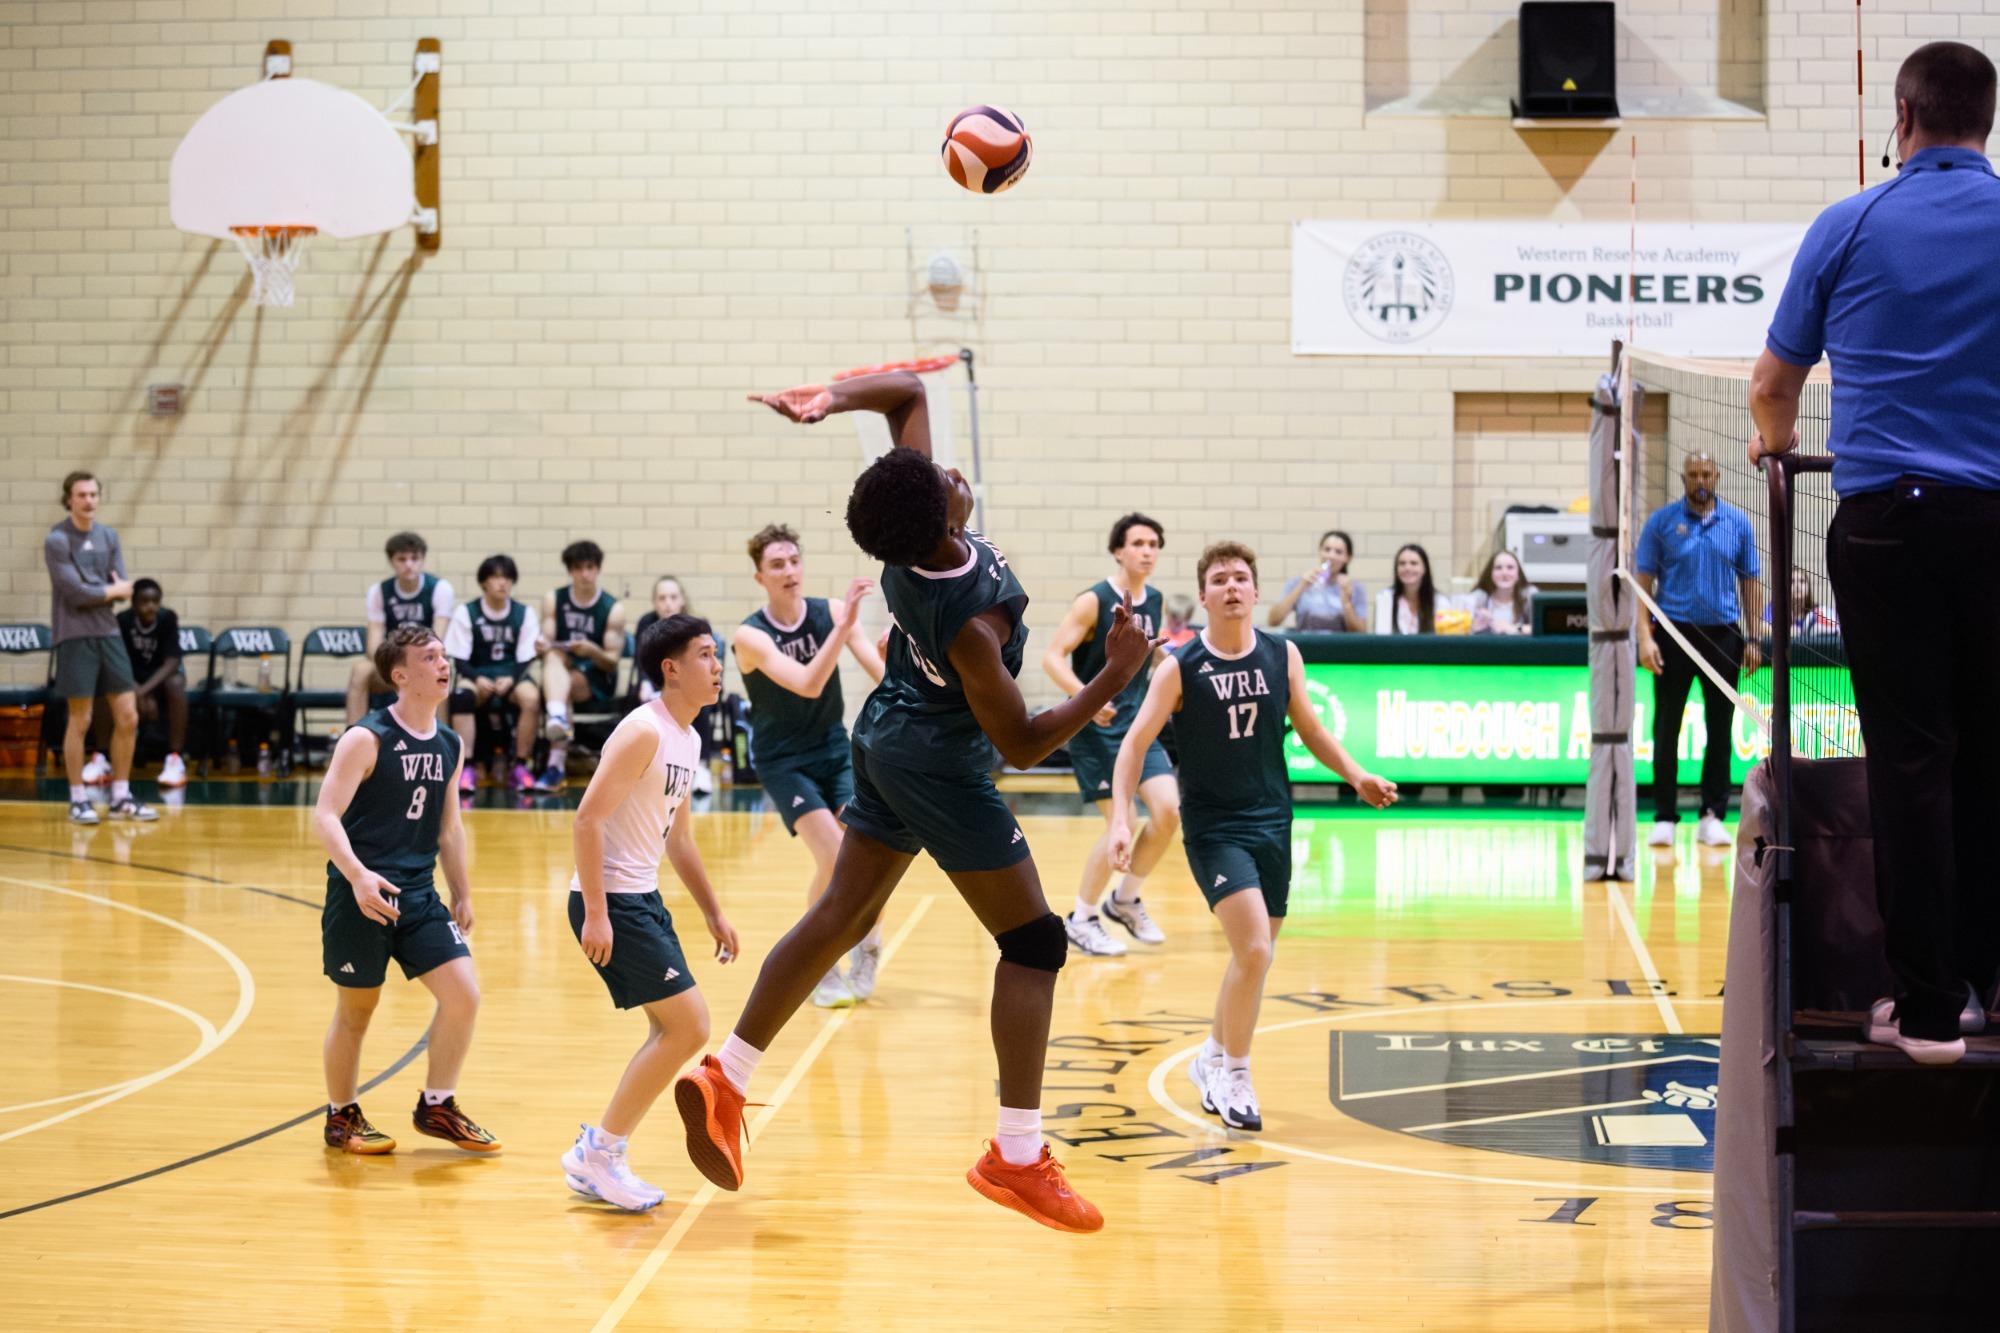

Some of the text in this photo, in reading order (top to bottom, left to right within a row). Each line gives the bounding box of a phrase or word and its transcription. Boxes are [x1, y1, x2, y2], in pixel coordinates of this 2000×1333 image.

[1517, 246, 1740, 267] Western Reserve Academy
[1494, 273, 1764, 303] PIONEERS
[1586, 312, 1673, 328] Basketball
[230, 629, 275, 652] WRA
[316, 628, 364, 652] WRA
[1209, 669, 1270, 701] WRA
[1227, 702, 1258, 739] 17
[401, 753, 444, 782] WRA
[406, 785, 427, 820] 8
[1373, 1034, 1545, 1052] Lux
